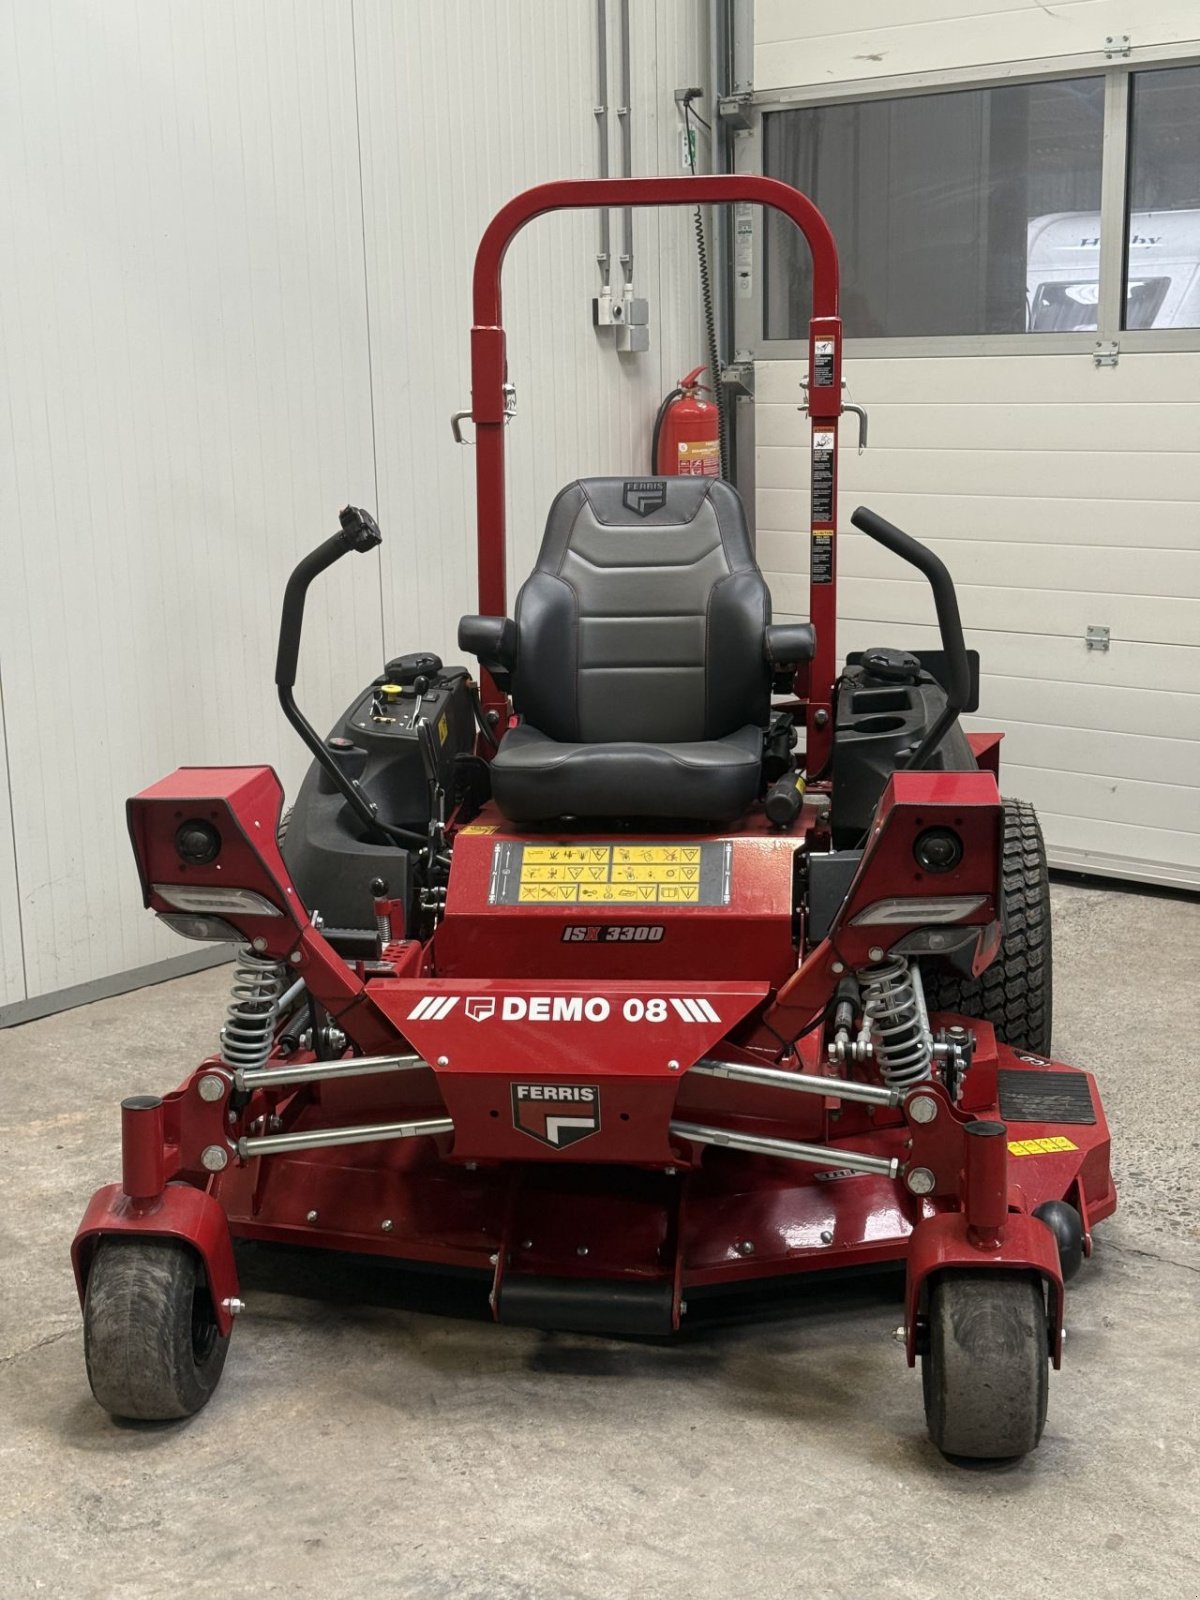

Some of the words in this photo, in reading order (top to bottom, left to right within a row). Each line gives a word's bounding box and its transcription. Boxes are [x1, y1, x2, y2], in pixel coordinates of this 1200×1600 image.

[1080, 235, 1162, 249] Hby
[563, 926, 600, 941] ISX
[606, 926, 664, 941] 3300
[502, 996, 610, 1022] DEMO
[623, 998, 668, 1023] 08
